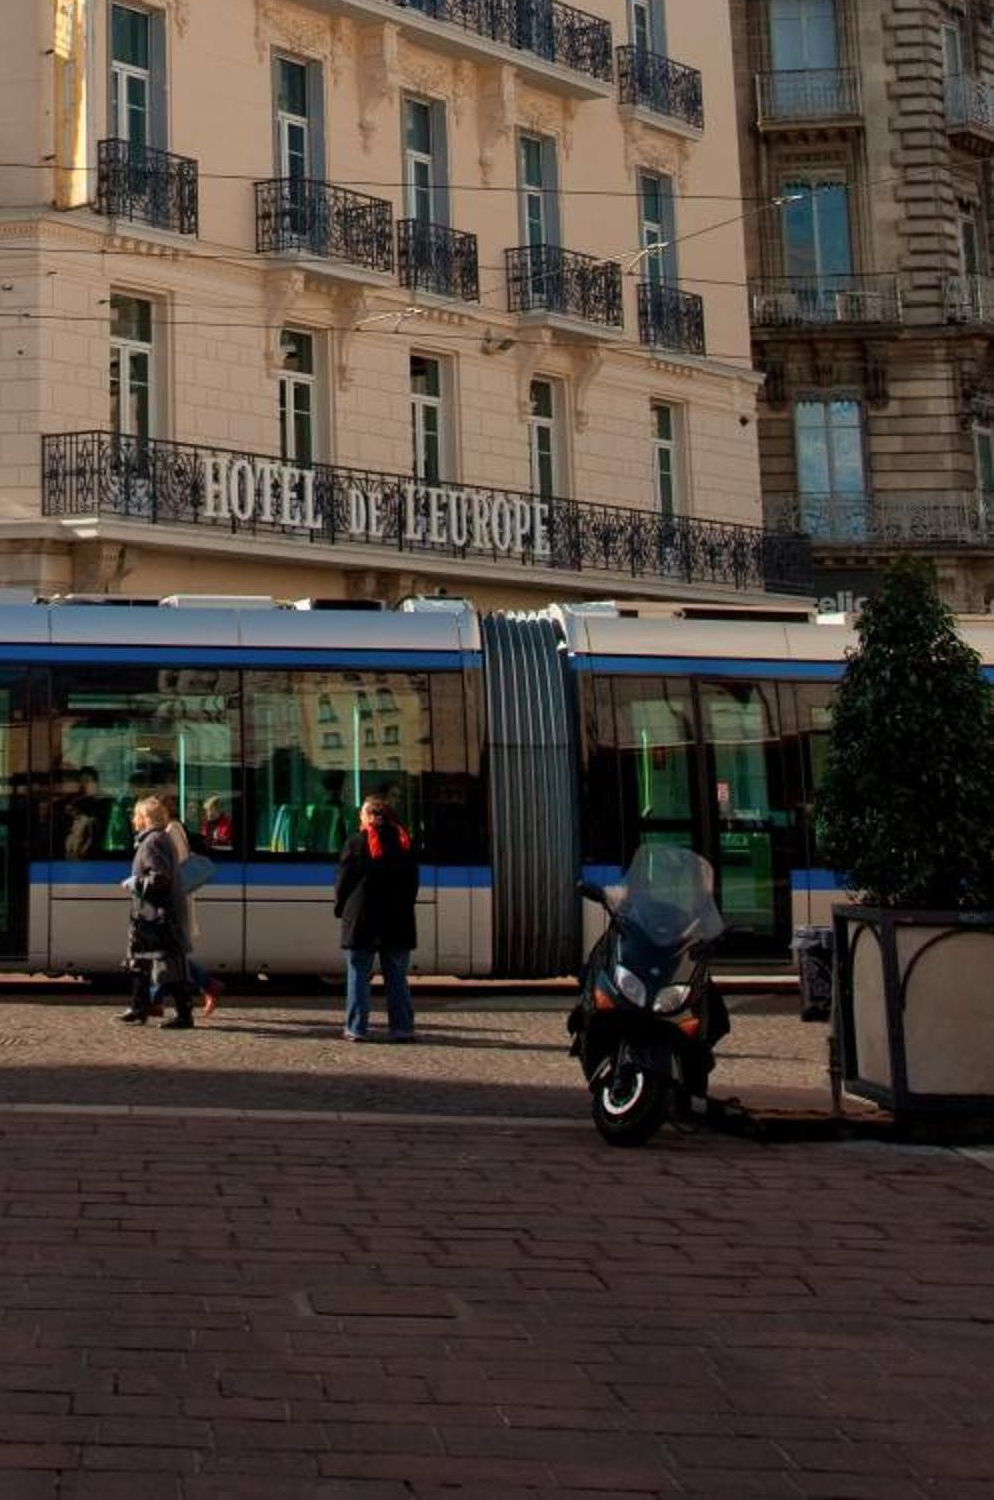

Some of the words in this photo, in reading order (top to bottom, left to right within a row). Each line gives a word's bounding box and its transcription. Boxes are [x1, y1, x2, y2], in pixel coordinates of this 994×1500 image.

[202, 457, 323, 530] HOTEL
[349, 487, 384, 537] DE
[405, 482, 552, 555] L'EUROPE
